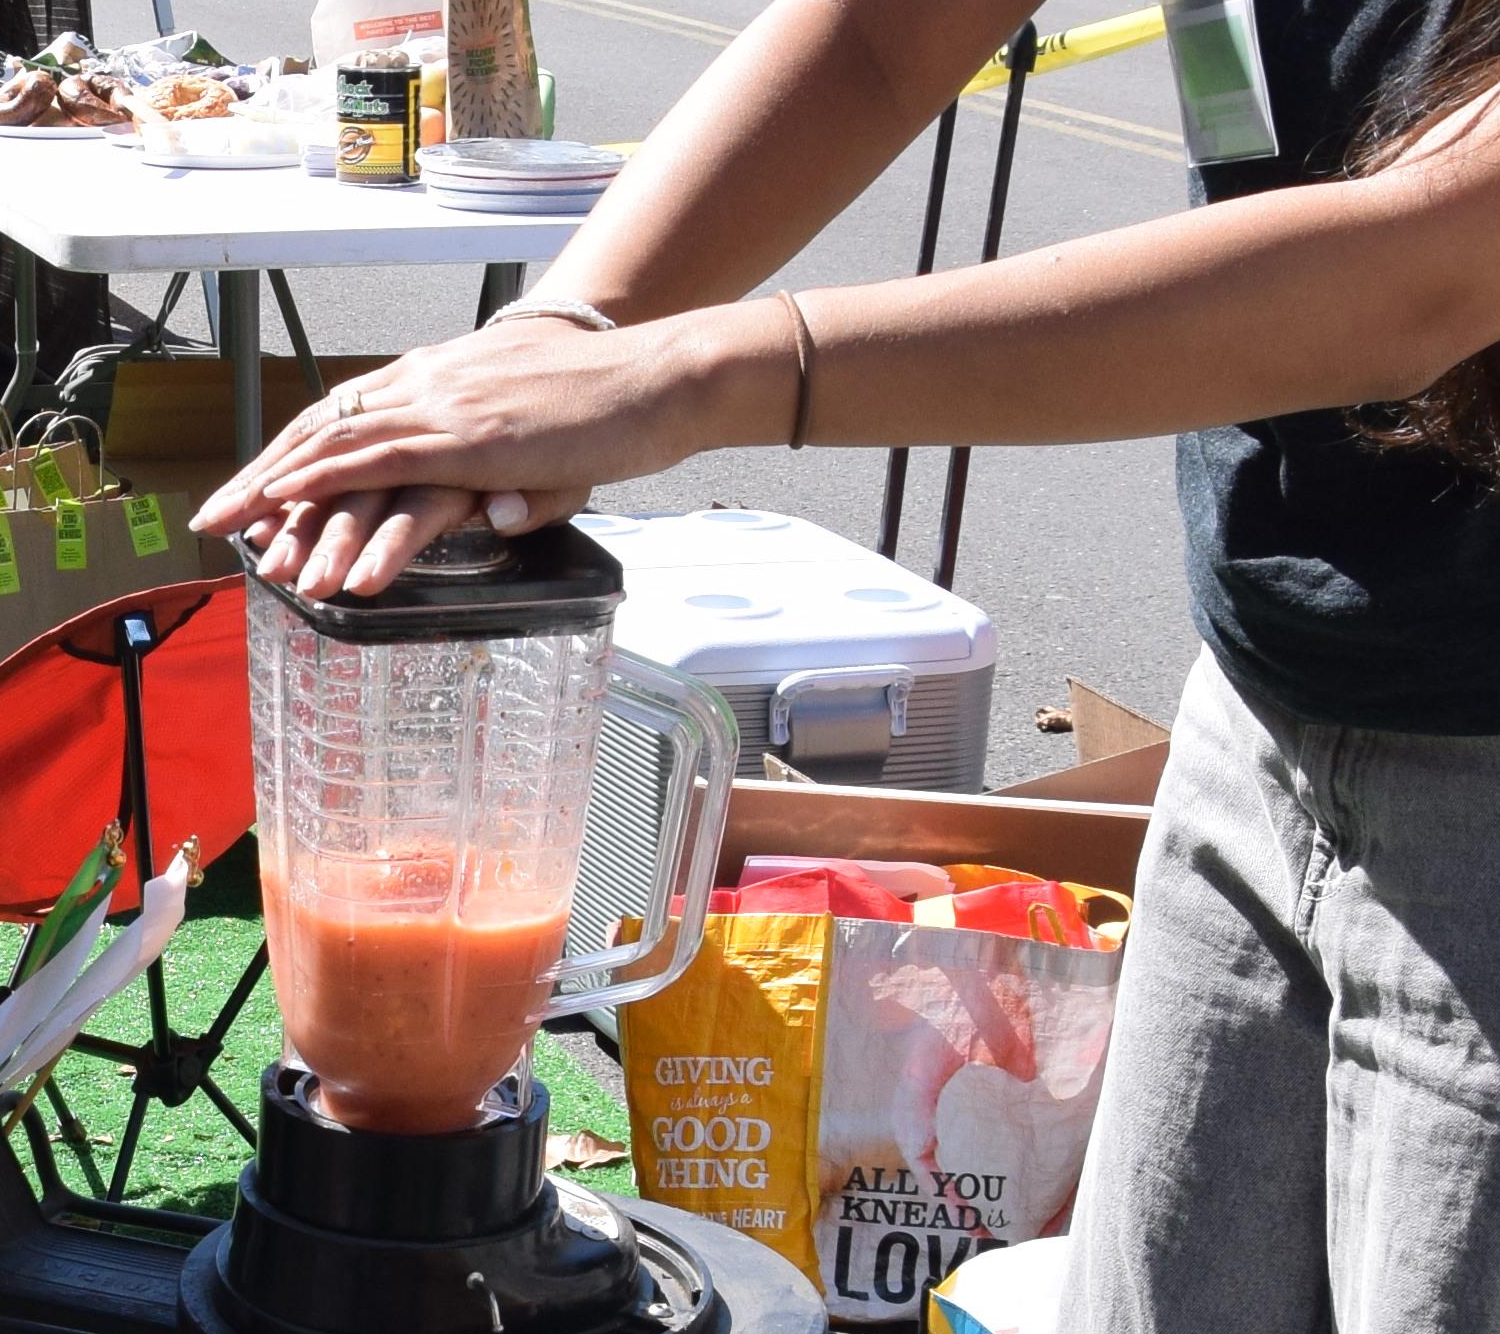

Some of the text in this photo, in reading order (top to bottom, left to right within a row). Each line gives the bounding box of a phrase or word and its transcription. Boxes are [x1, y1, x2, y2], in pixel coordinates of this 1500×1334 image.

[654, 1056, 775, 1086] GIVING
[671, 1087, 753, 1115] is always a
[652, 1116, 772, 1152] GOOD
[656, 1158, 770, 1189] THING
[842, 1166, 1008, 1202] ALL YOU
[732, 1208, 787, 1229] HEART
[839, 1195, 1011, 1231] KNEAD is
[834, 1226, 1009, 1305] LOV
